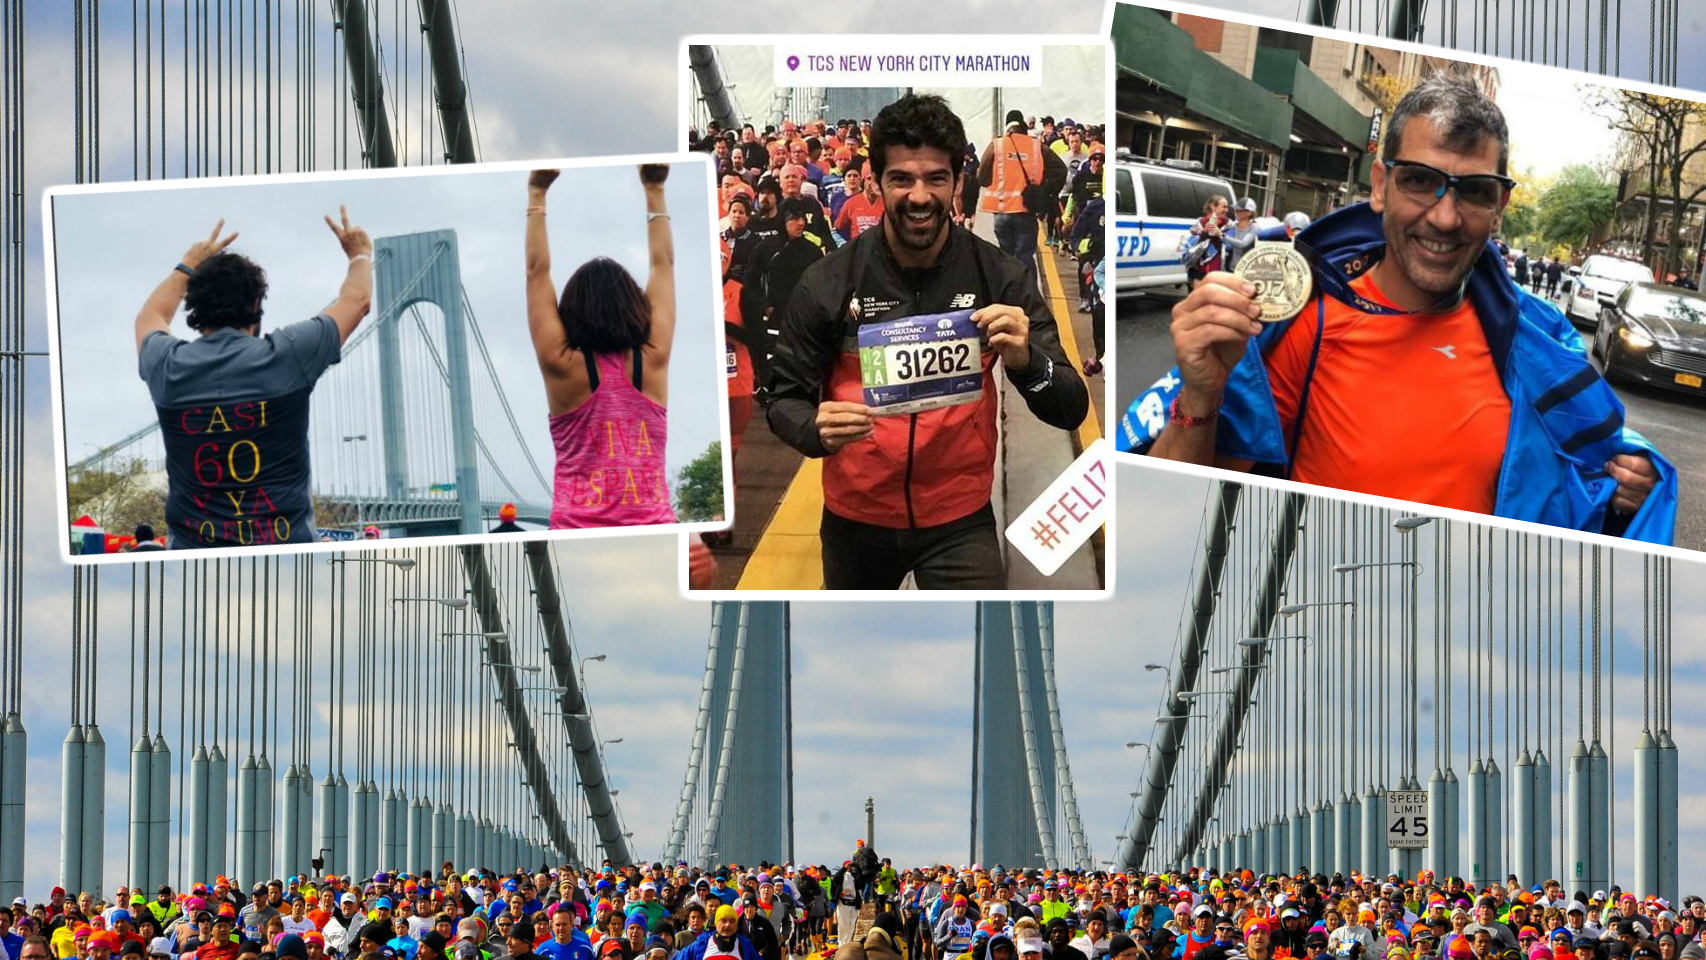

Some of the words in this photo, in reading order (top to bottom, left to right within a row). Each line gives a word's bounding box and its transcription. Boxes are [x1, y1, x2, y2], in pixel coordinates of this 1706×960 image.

[881, 326, 927, 336] CONSULTANCY
[890, 334, 920, 343] SERVICES
[936, 329, 956, 337] TATA
[896, 344, 971, 380] 31262
[181, 401, 268, 434] CASI
[588, 418, 651, 458] VIVA
[193, 440, 261, 487] 60
[224, 487, 276, 516] YA
[1390, 795, 1427, 803] SPEED
[1394, 805, 1423, 814] LIMIT
[1390, 817, 1428, 837] 45
